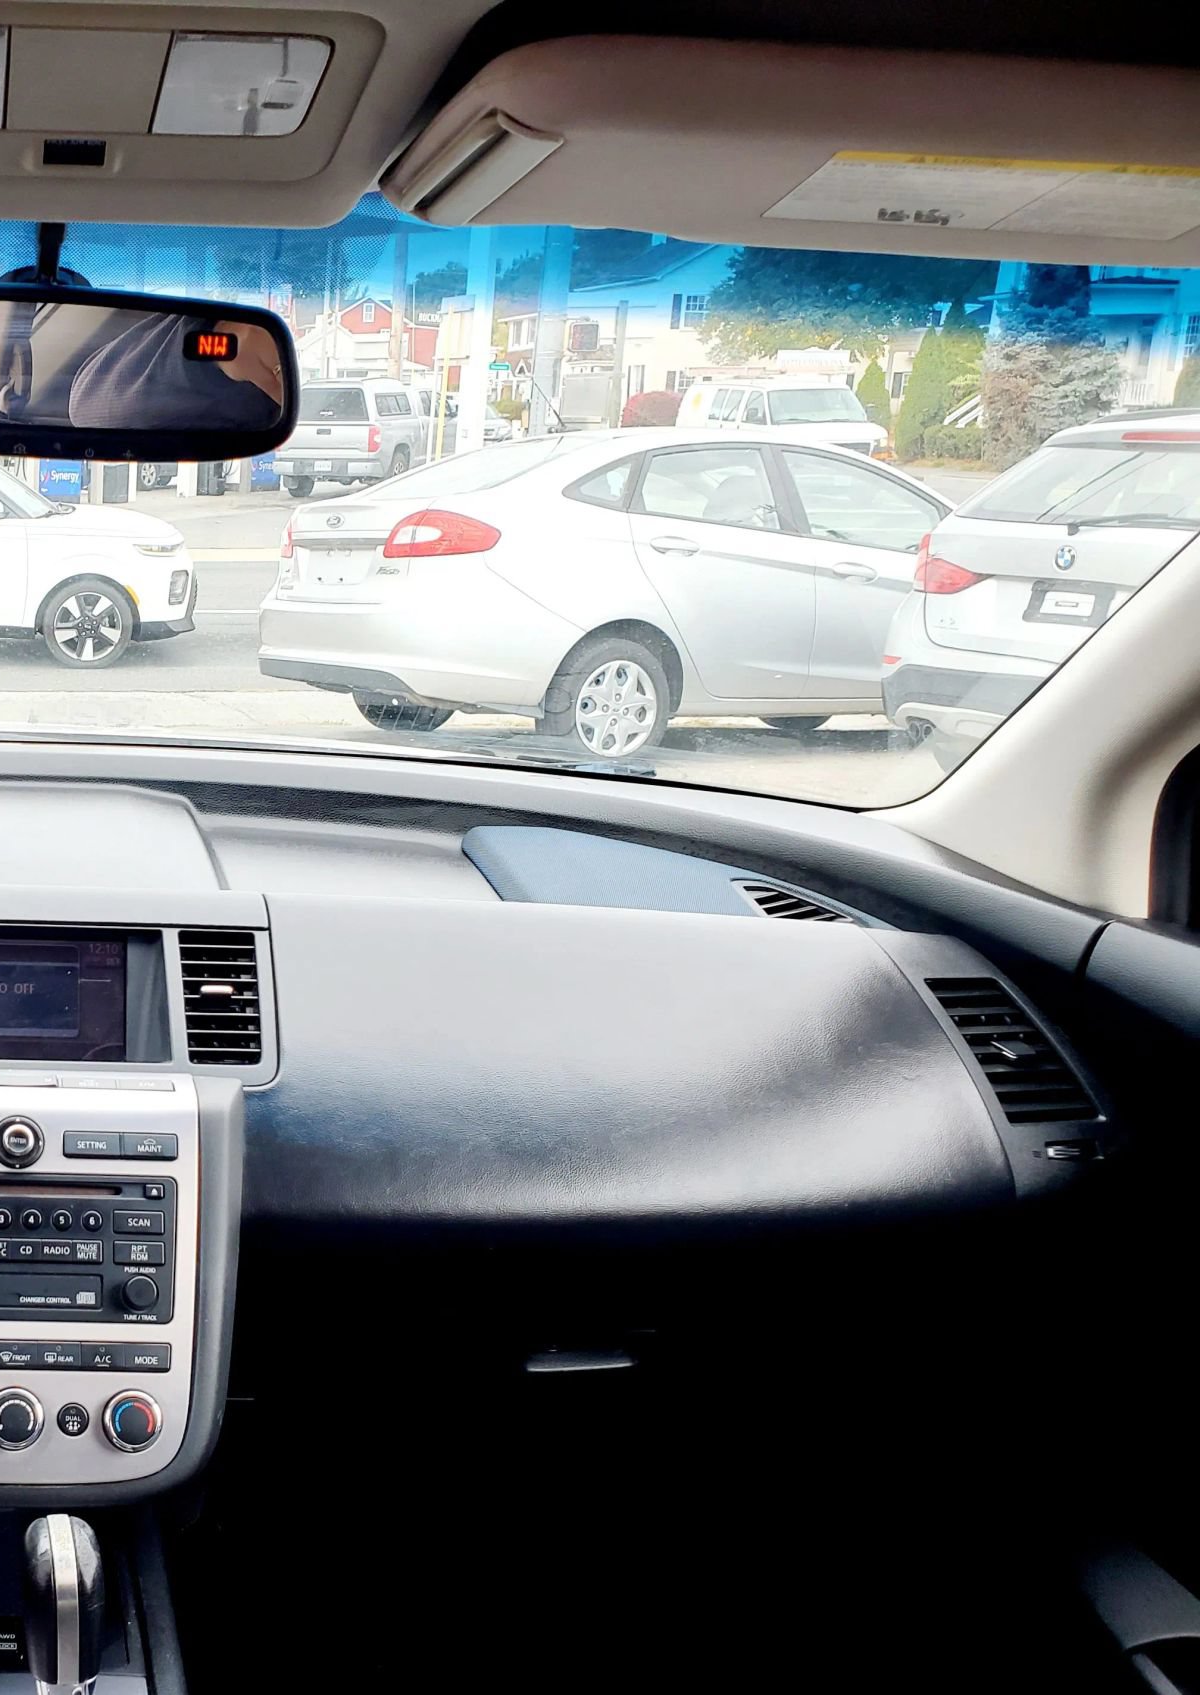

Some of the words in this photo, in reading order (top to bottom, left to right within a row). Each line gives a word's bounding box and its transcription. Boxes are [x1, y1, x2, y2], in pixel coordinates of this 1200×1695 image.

[199, 335, 227, 356] NW
[50, 470, 80, 484] Synergy
[14, 983, 36, 994] OFF
[76, 1141, 107, 1150] SETTING
[137, 1145, 162, 1153] MAINT
[0, 1215, 4, 1223] 3
[28, 1215, 34, 1223] 4
[59, 1216, 65, 1224] 5
[89, 1217, 95, 1225] 6
[127, 1217, 151, 1227] SCAN
[19, 1246, 33, 1255] CD
[43, 1246, 71, 1255] RADIO
[131, 1245, 148, 1253] RPT
[77, 1252, 97, 1260] MUTE
[130, 1253, 149, 1261] RDM
[94, 1355, 112, 1363] A/C
[134, 1356, 159, 1365] MODE
